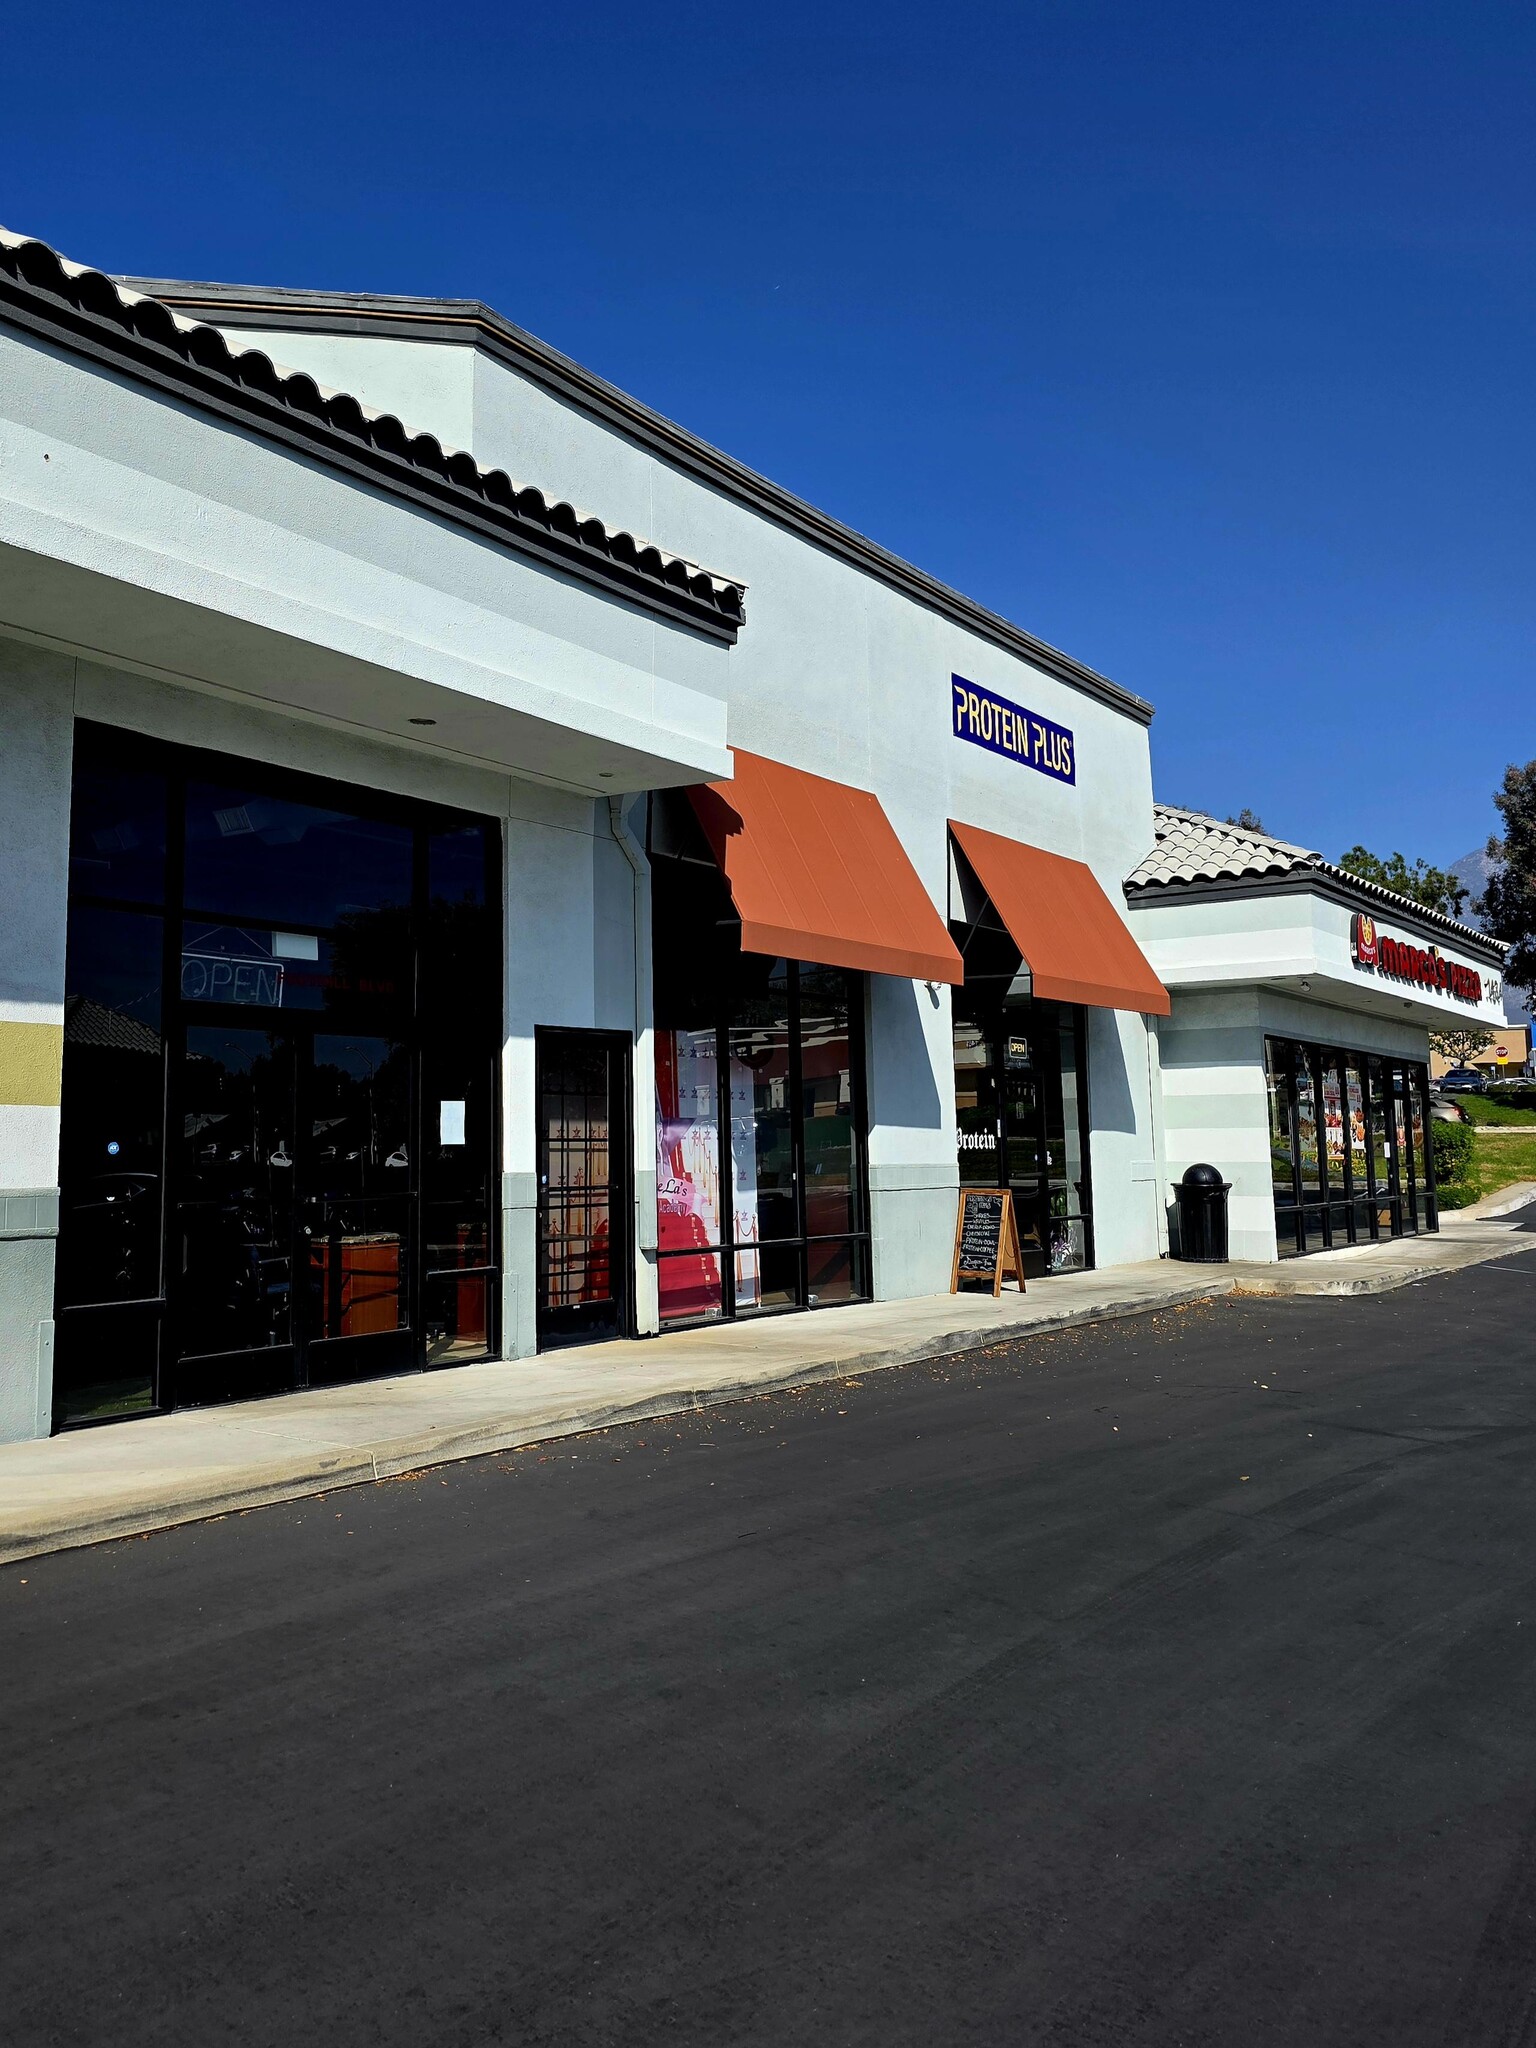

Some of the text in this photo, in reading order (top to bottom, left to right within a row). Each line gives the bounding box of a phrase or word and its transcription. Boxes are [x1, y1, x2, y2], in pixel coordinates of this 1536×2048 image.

[954, 685, 1071, 775] PROTEIN PLUS
[181, 959, 279, 1004] OPEN
[1450, 962, 1483, 1001] PIZZA
[1010, 1042, 1025, 1053] OPEN
